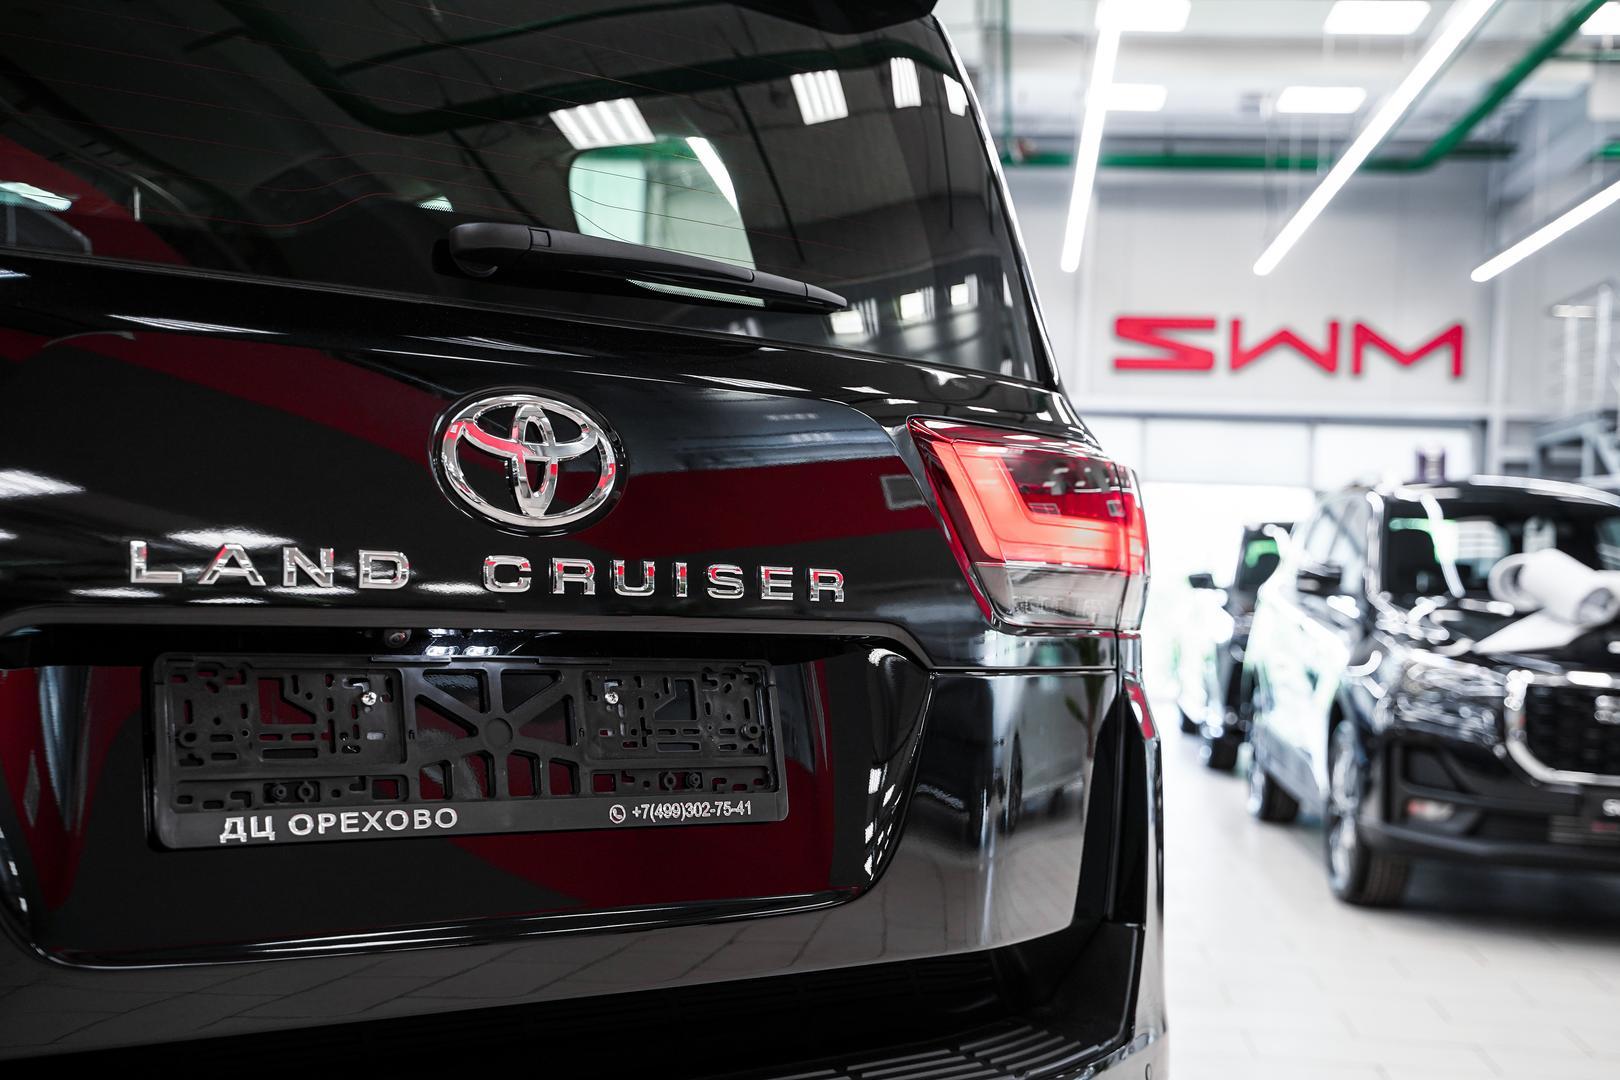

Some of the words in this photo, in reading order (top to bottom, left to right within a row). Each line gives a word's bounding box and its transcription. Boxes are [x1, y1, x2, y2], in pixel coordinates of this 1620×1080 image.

[1114, 315, 1464, 378] SWM
[130, 540, 410, 589] LAND
[483, 554, 845, 603] CRUISER
[219, 815, 276, 843] ДЦ
[288, 807, 458, 835] ОРЕХОВО
[631, 800, 752, 823] +7(499)302-75-41
